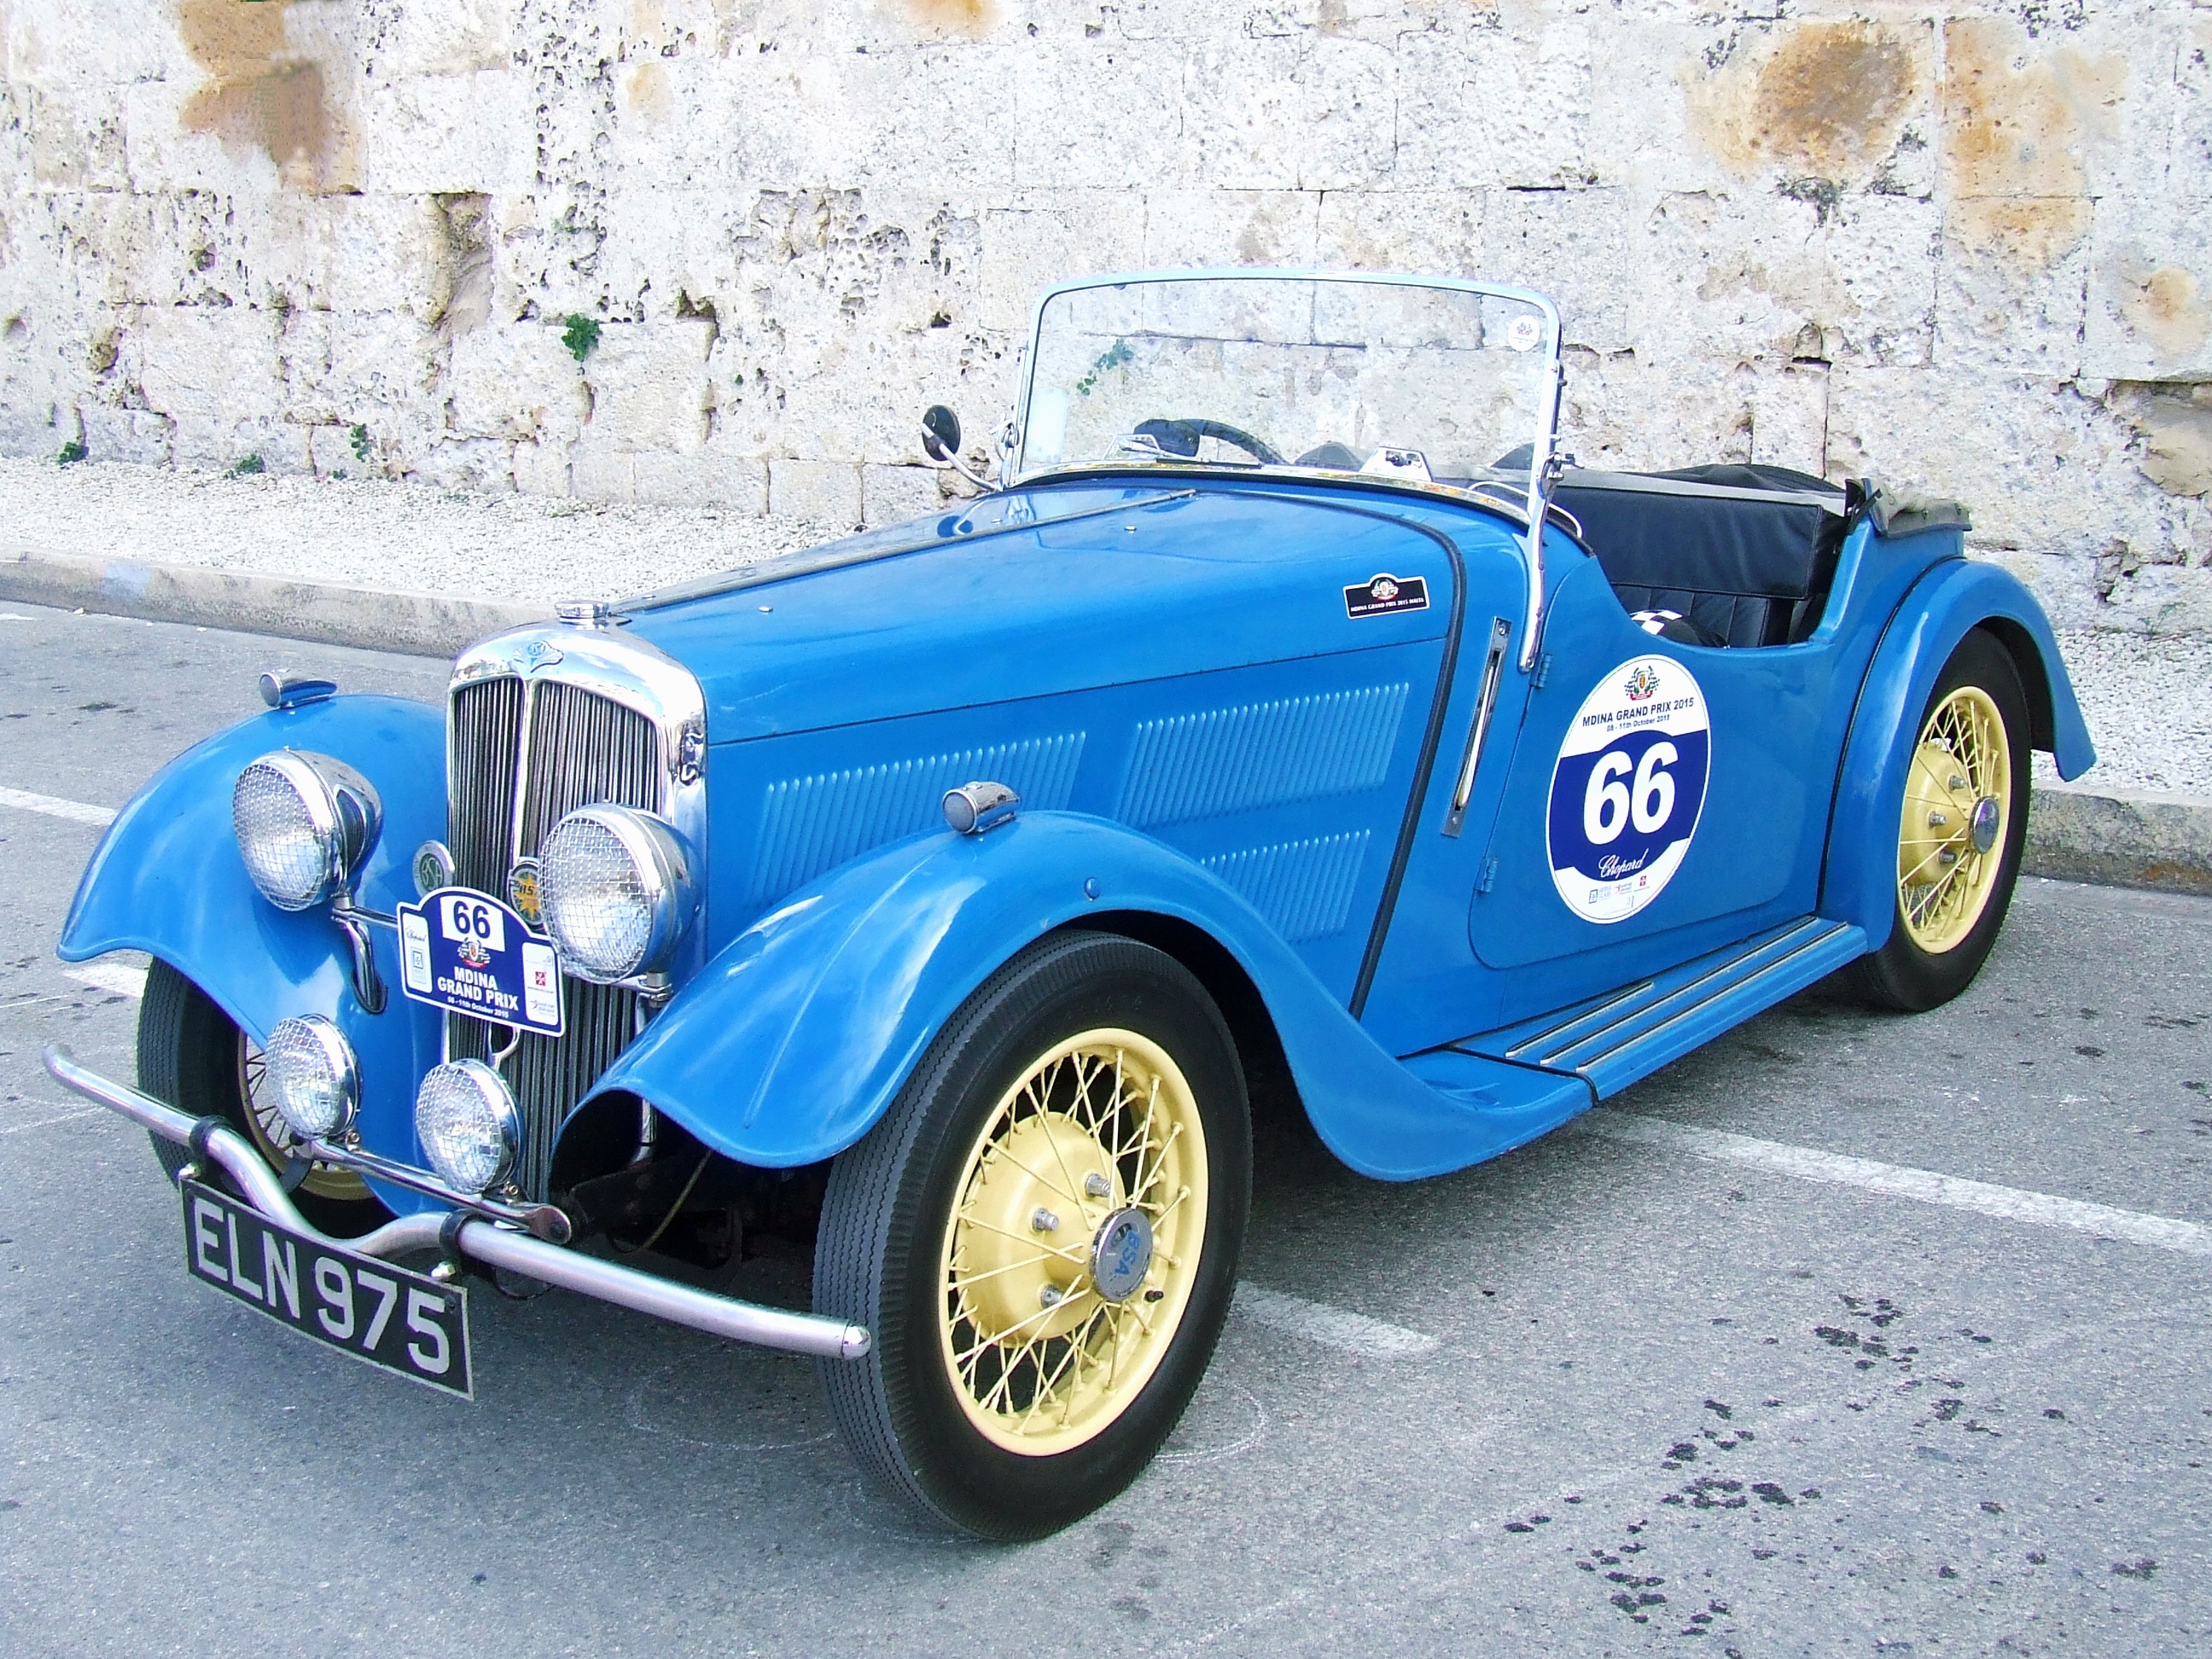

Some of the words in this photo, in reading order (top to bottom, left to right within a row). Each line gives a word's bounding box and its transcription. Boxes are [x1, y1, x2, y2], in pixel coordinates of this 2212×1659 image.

[1582, 713, 1613, 727] MDINA
[1616, 706, 1648, 721] GRAND
[1650, 701, 1671, 715] PRIX
[1674, 697, 1694, 711] 2015
[1633, 718, 1655, 727] October
[1583, 741, 1679, 846] 66
[1598, 847, 1649, 879] Chopard
[453, 900, 491, 939] 66
[437, 976, 482, 1001] GRAND
[486, 989, 519, 1011] PRIX
[454, 966, 498, 990] MDINA
[471, 1003, 494, 1014] October
[1115, 1230, 1140, 1275] BSA
[194, 1196, 300, 1319] ELN
[314, 1256, 450, 1375] 975
